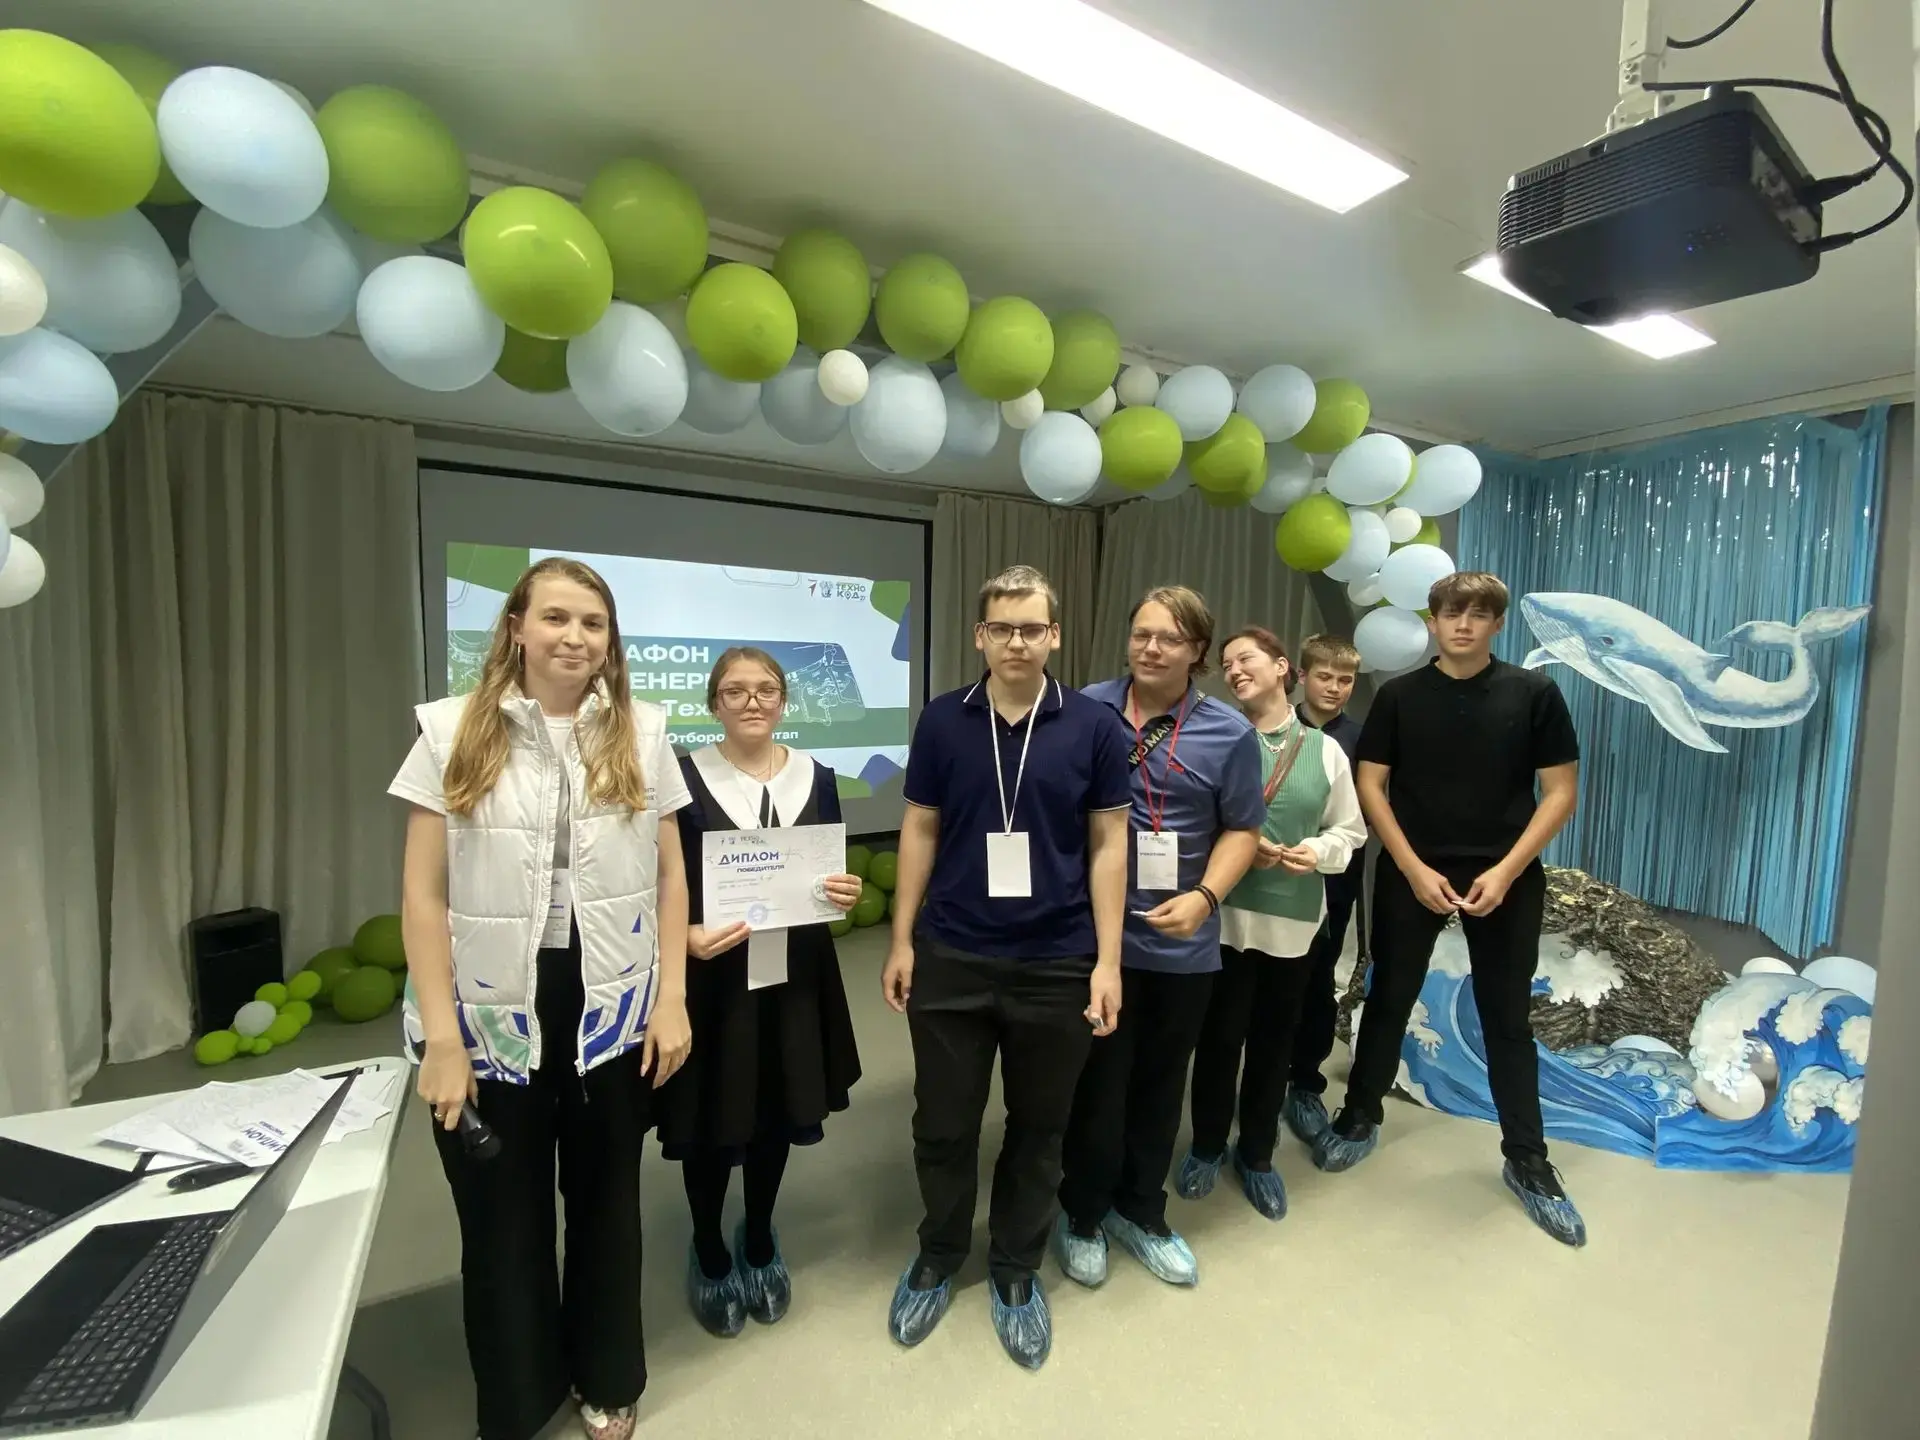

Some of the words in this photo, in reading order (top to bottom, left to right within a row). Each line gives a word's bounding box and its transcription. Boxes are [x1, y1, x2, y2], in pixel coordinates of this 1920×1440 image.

[625, 644, 709, 664] АФОН
[629, 672, 711, 690] ЕНЕР
[666, 732, 725, 745] Отборо
[718, 851, 780, 866] ДИПЛОМ
